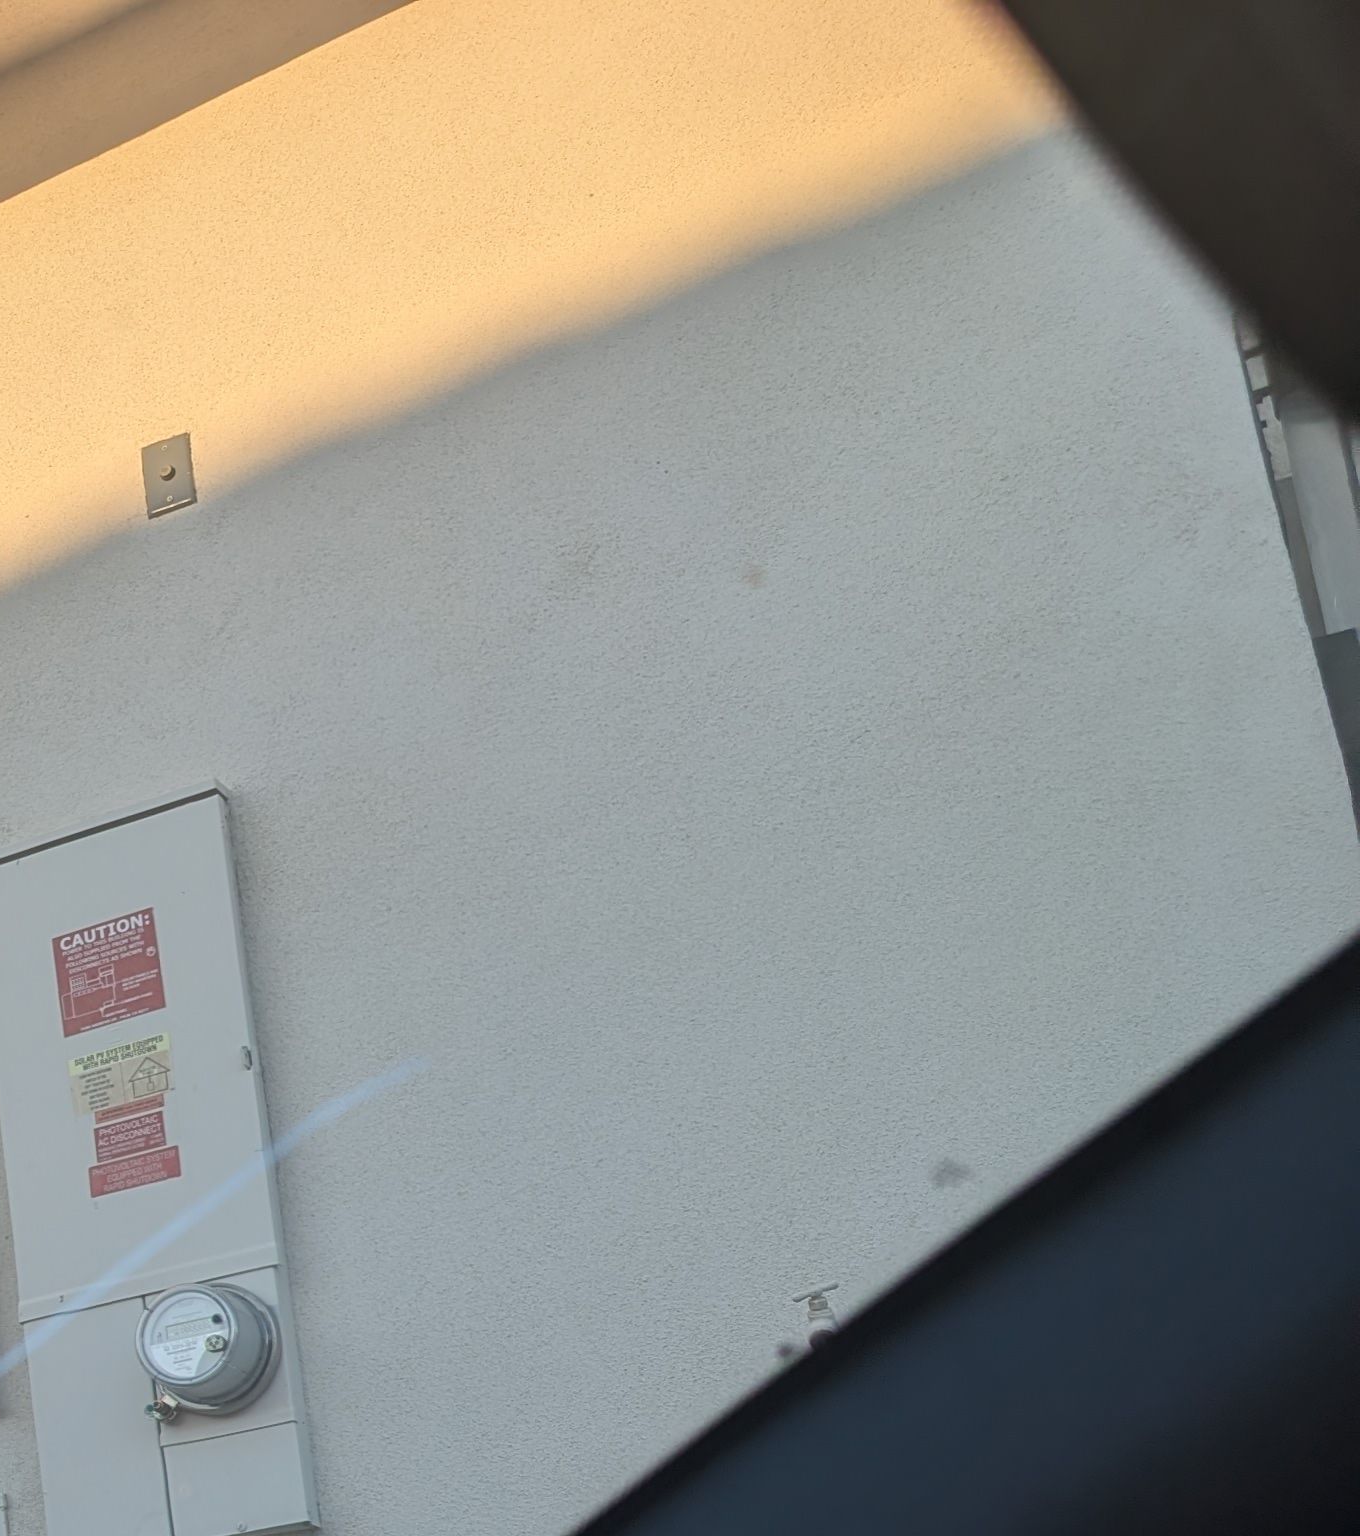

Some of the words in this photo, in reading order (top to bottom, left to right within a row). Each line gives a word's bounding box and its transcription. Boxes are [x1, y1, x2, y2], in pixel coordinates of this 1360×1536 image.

[60, 913, 150, 950] CAUTION:
[61, 946, 82, 956] POWER
[93, 938, 106, 947] THIS
[65, 953, 99, 968] FOLLOWING
[100, 945, 127, 957] SOURCES
[128, 939, 144, 949] WITH
[83, 943, 110, 956] SUPPLIED
[111, 938, 128, 947] FROM
[129, 934, 140, 942] THE
[69, 957, 109, 974] DISCONNECTS
[119, 947, 142, 958] SHOWN
[100, 1054, 118, 1065] RAPID
[121, 1044, 157, 1060] SHUTDOWN
[105, 1043, 130, 1057] SYSTEM
[132, 1035, 163, 1050] EQUIPPED
[97, 1136, 109, 1147] AC
[110, 1122, 161, 1143] DISCONNECT
[98, 1114, 158, 1136] PHOTOVOLTAIC
[92, 1157, 144, 1176] PHOTOVOLTAIC
[146, 1149, 176, 1162] SYSTEM
[106, 1166, 142, 1182] EQUIPPED
[143, 1161, 161, 1173] WITH
[103, 1180, 125, 1192] RAPID
[126, 1170, 167, 1186] SHUTDOWN
